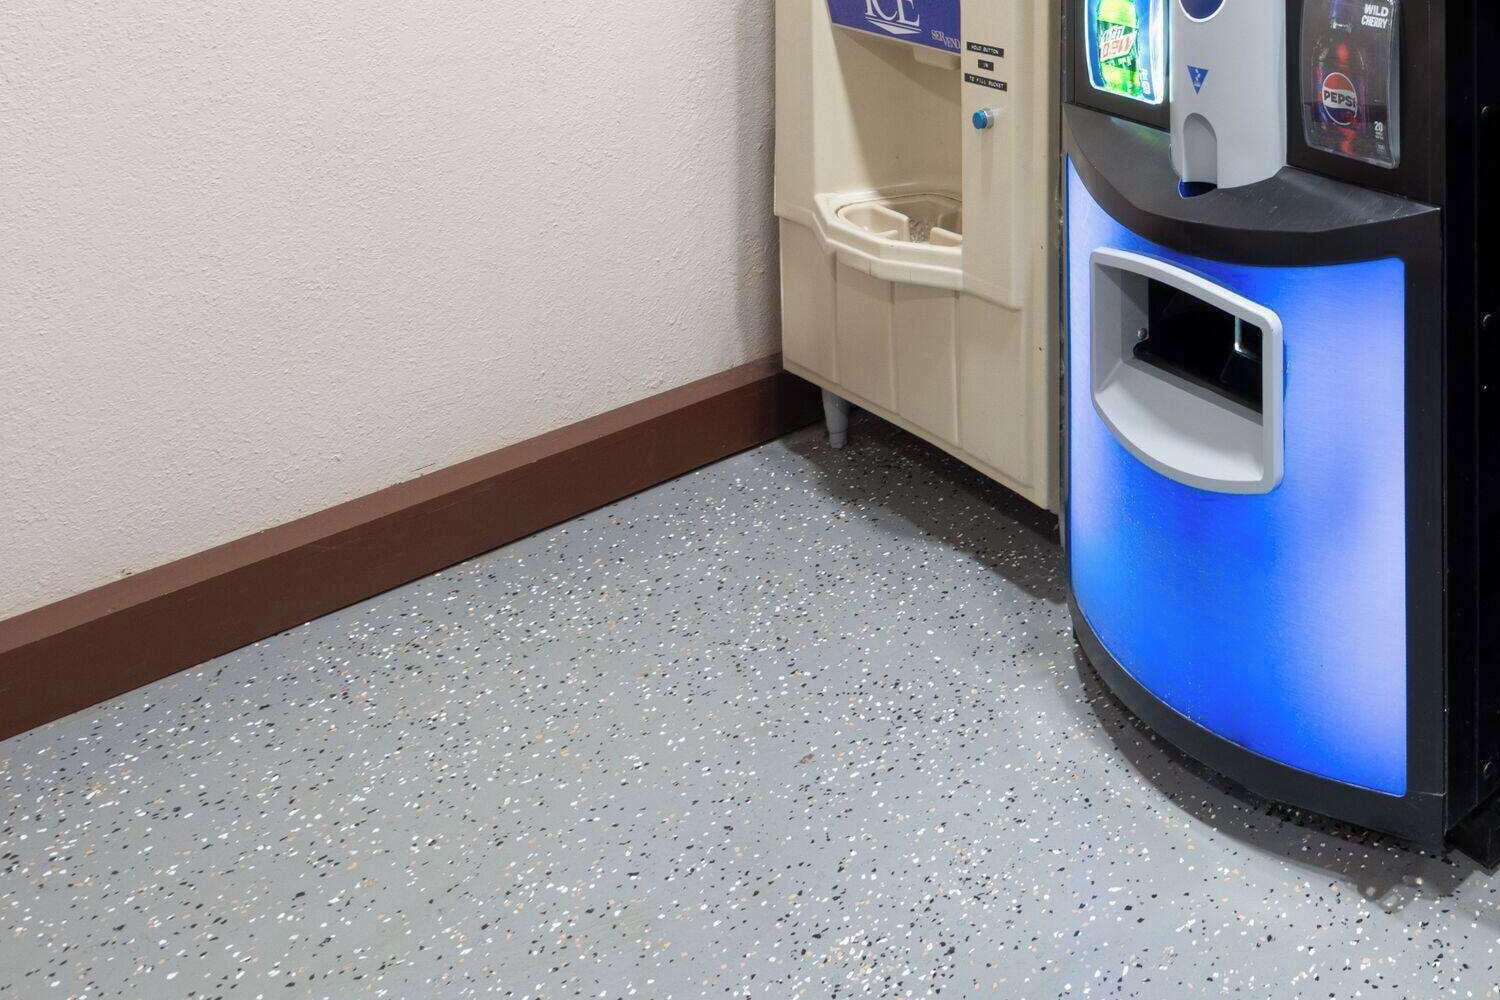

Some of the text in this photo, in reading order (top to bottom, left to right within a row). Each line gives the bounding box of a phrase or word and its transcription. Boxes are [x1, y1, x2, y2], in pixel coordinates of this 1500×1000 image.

[1364, 3, 1389, 17] WILD
[1361, 14, 1389, 29] CHERRY
[1374, 121, 1383, 132] 20
